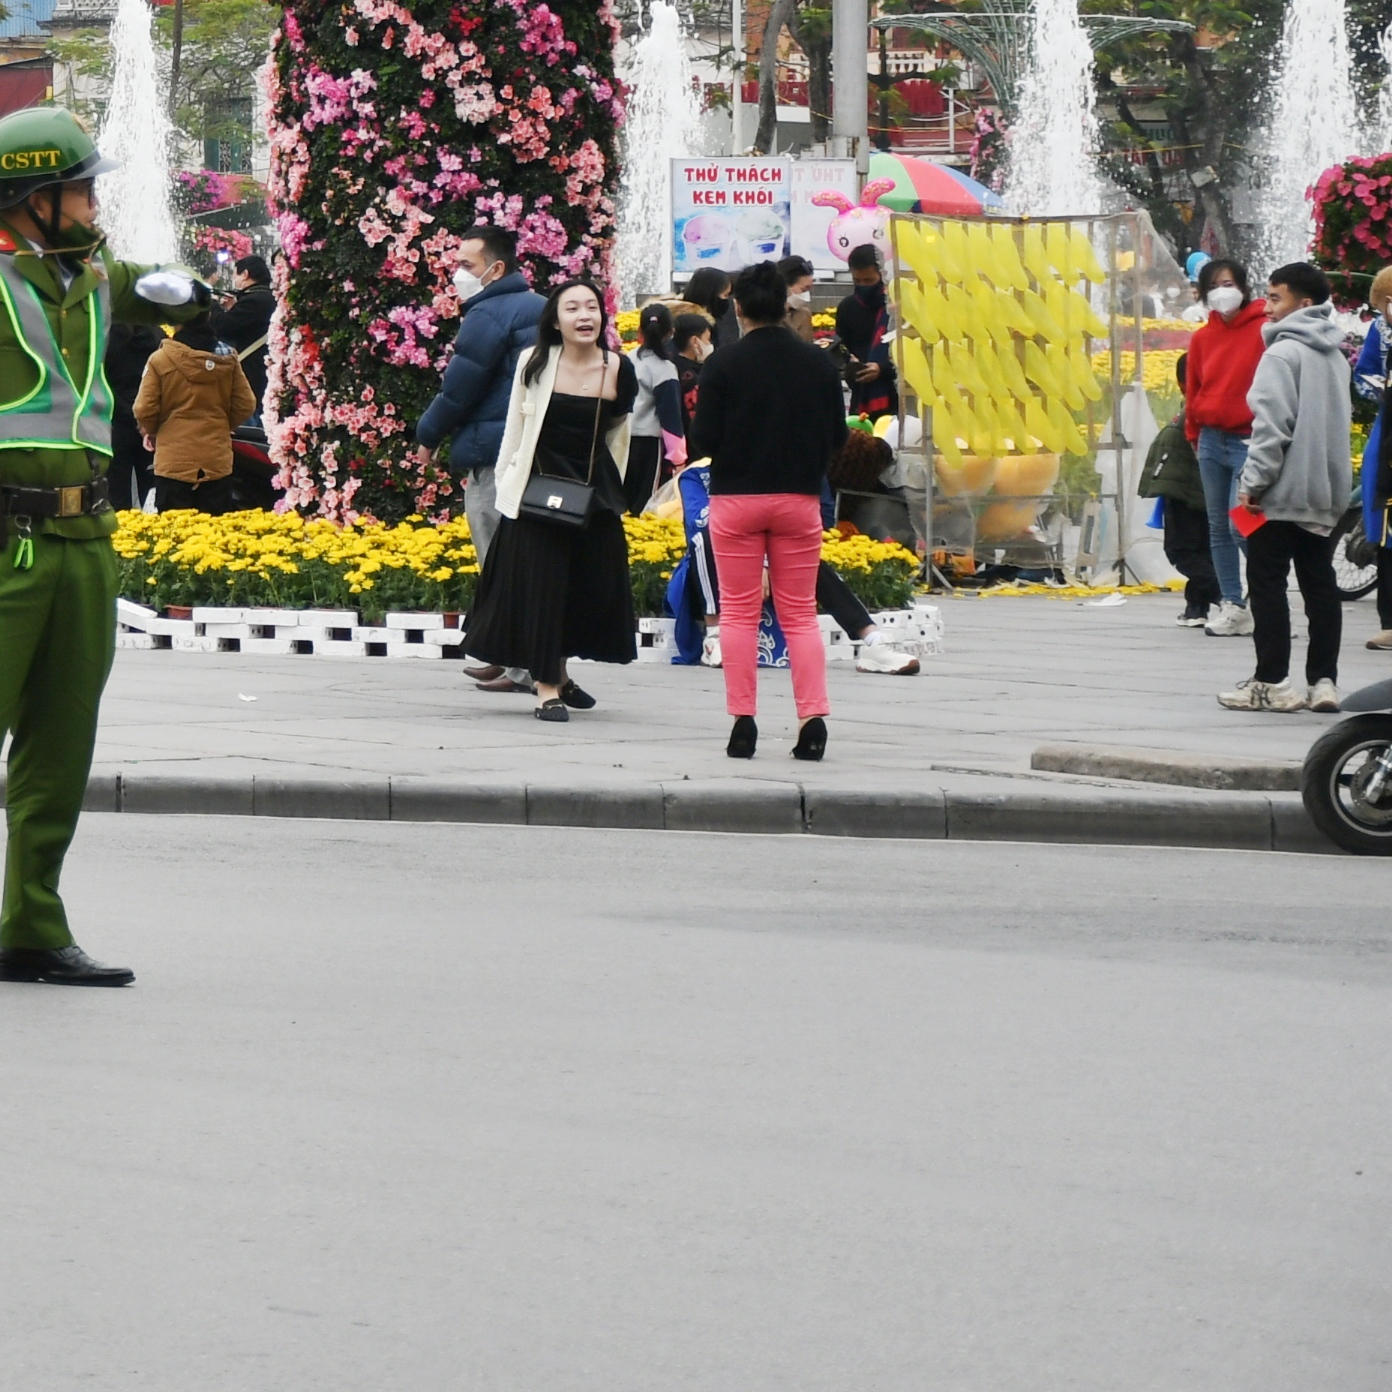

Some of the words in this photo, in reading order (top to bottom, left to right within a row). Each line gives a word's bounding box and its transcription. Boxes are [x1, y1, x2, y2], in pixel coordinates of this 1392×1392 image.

[1, 150, 61, 170] CSTT
[684, 162, 720, 182] THỬ
[724, 163, 783, 182] THÁCH
[693, 190, 726, 205] KEM
[733, 186, 774, 205] KHÓI
